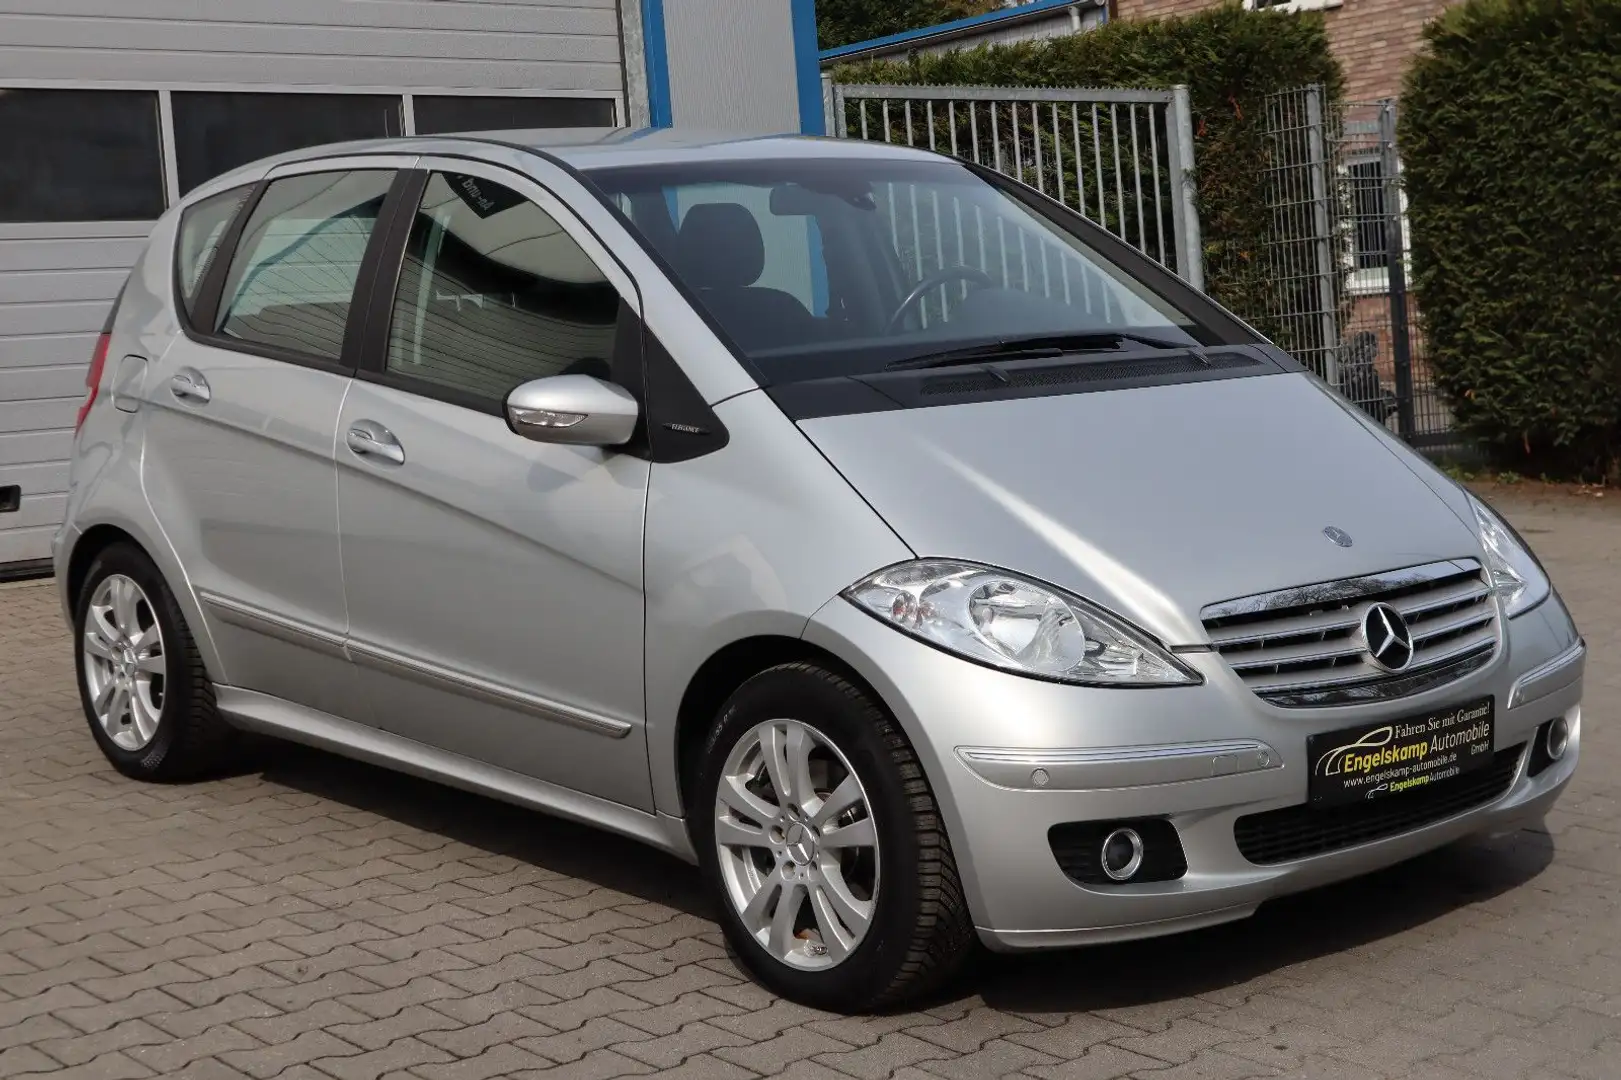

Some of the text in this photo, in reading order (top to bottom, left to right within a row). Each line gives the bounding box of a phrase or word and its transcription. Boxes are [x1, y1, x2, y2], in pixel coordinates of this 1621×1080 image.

[1394, 701, 1490, 739] Fahren Sie mit Garantie!
[1343, 721, 1490, 774] Engelskamp Automobile
[1470, 740, 1490, 755] GmbH
[1343, 752, 1457, 788] www.engelskamp-automobile.de
[1390, 766, 1460, 793] Engelskamp Automobile
